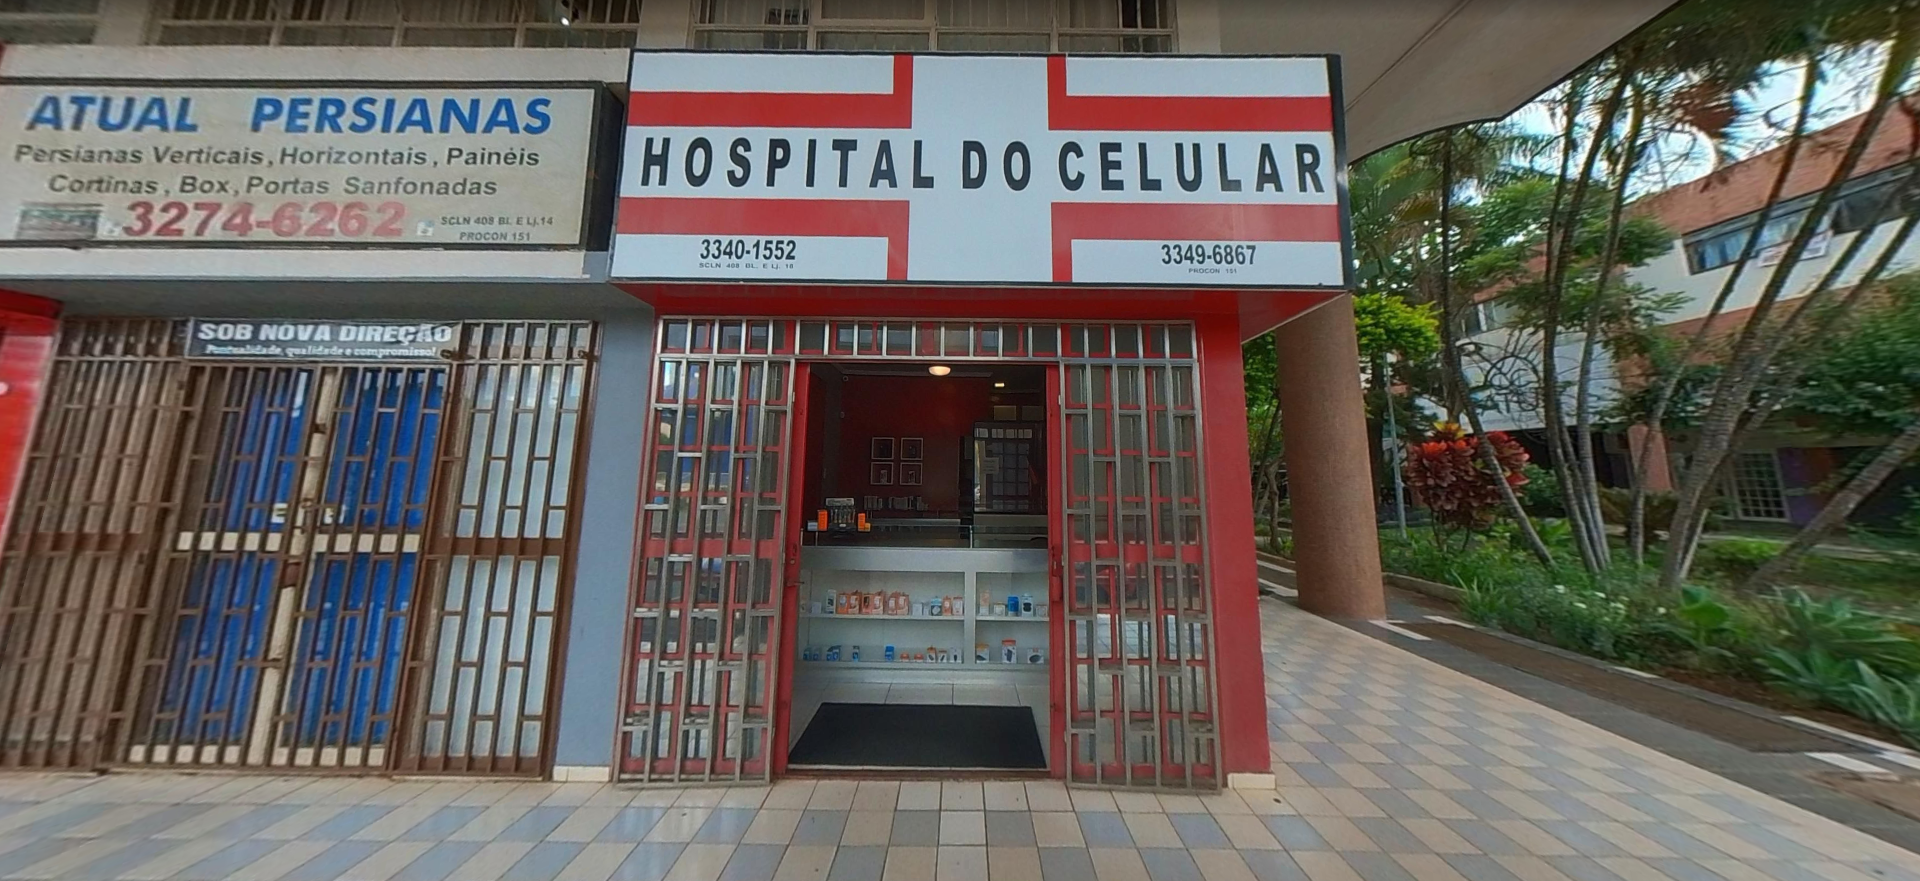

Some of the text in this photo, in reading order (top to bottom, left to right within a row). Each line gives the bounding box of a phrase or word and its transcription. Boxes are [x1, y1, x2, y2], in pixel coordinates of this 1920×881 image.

[25, 95, 552, 135] ATUAL PERSIANAS
[14, 144, 143, 164] Persianas
[446, 147, 540, 166] Painéis
[640, 137, 1325, 194] HOSPITAL DO CELULAR
[246, 176, 330, 195] Portas
[343, 176, 498, 196] Sanfonadas
[122, 200, 406, 238] 3274-6262
[441, 216, 471, 226] SCLN
[474, 216, 495, 226] 408
[516, 216, 524, 226] E
[459, 231, 531, 241] PROCON 151
[700, 239, 797, 261] 3340-1552
[1161, 243, 1257, 265] 3349-6867
[198, 323, 453, 346] SOB NOVA DIREÇÃO
[285, 345, 344, 357] qualidade
[345, 347, 353, 356] e
[354, 346, 438, 359] compromisso!
